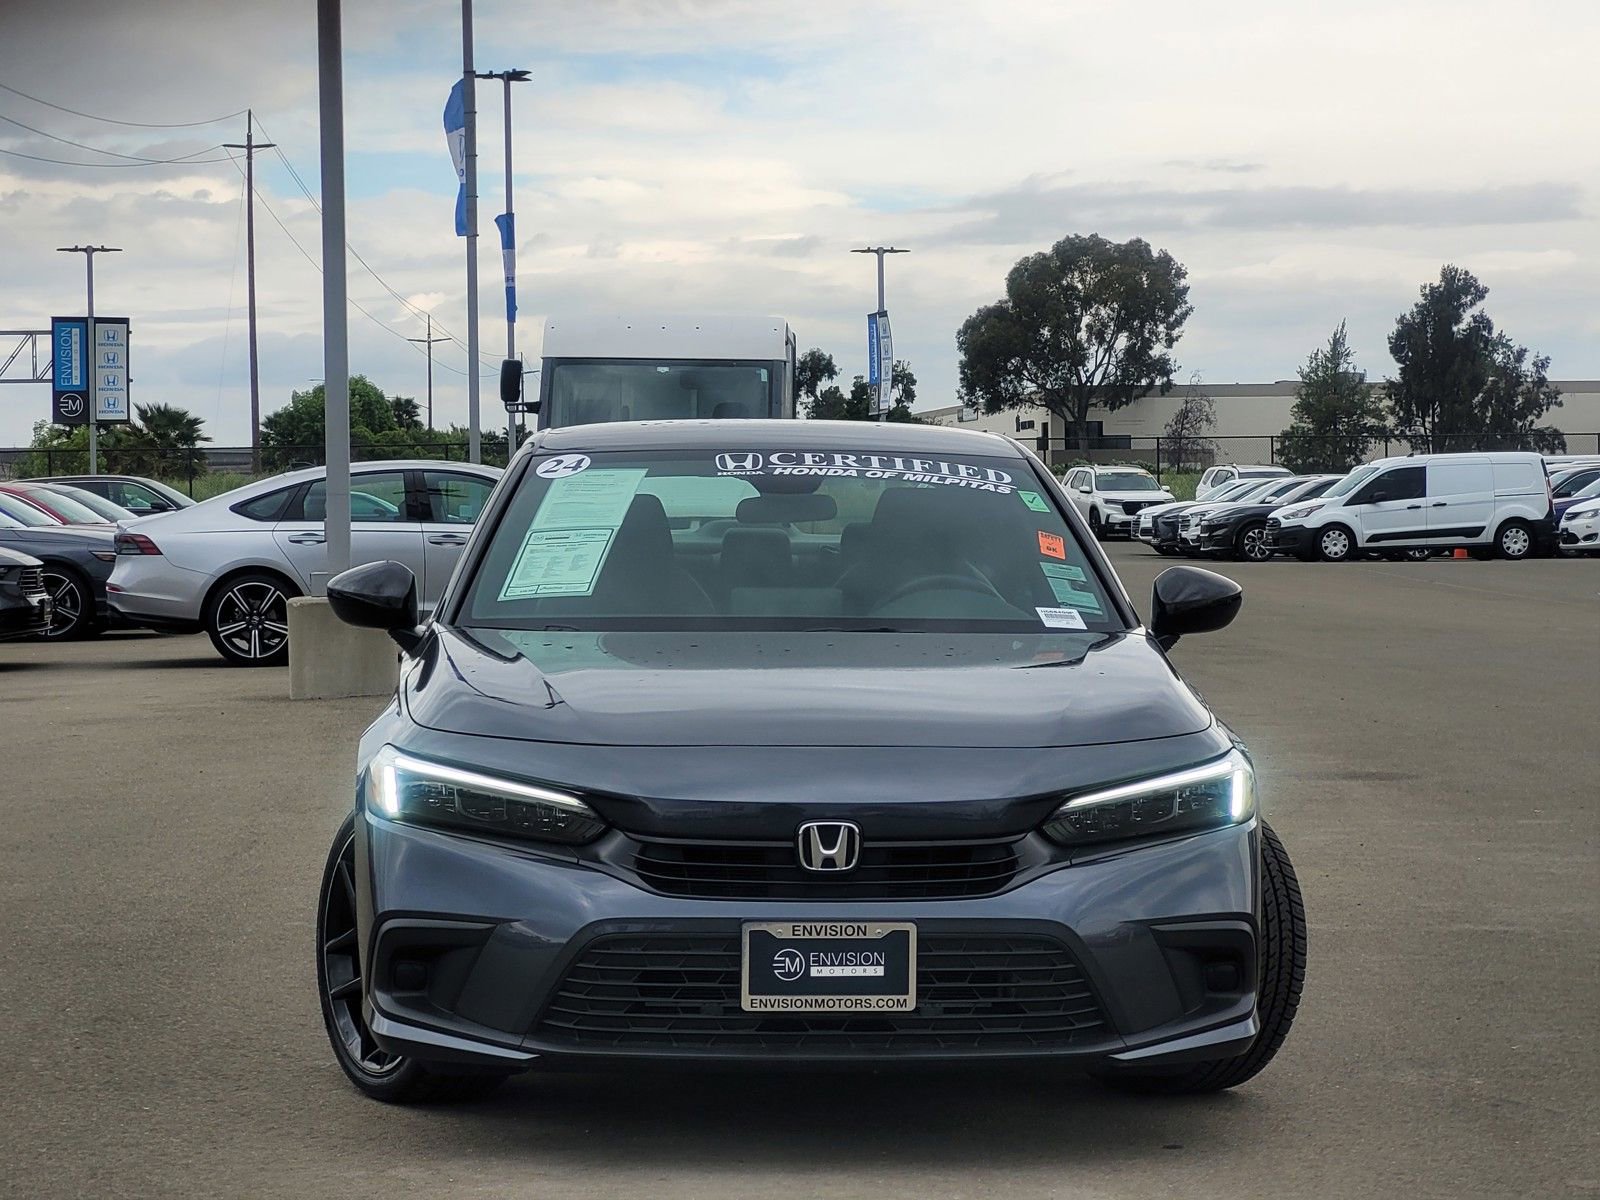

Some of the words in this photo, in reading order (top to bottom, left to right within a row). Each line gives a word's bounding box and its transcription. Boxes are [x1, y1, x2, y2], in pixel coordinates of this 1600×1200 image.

[60, 327, 71, 386] ENVISION
[539, 457, 587, 475] 24
[768, 452, 1012, 484] CERTIFIED
[773, 467, 858, 477] HONDA
[865, 470, 899, 479] OF
[902, 473, 1012, 495] MILPITAS
[791, 924, 868, 937] ENVISION
[810, 952, 885, 966] ENVISION
[816, 967, 878, 975] MOTORS
[750, 998, 908, 1009] ENVISIONMOTORS.COM
